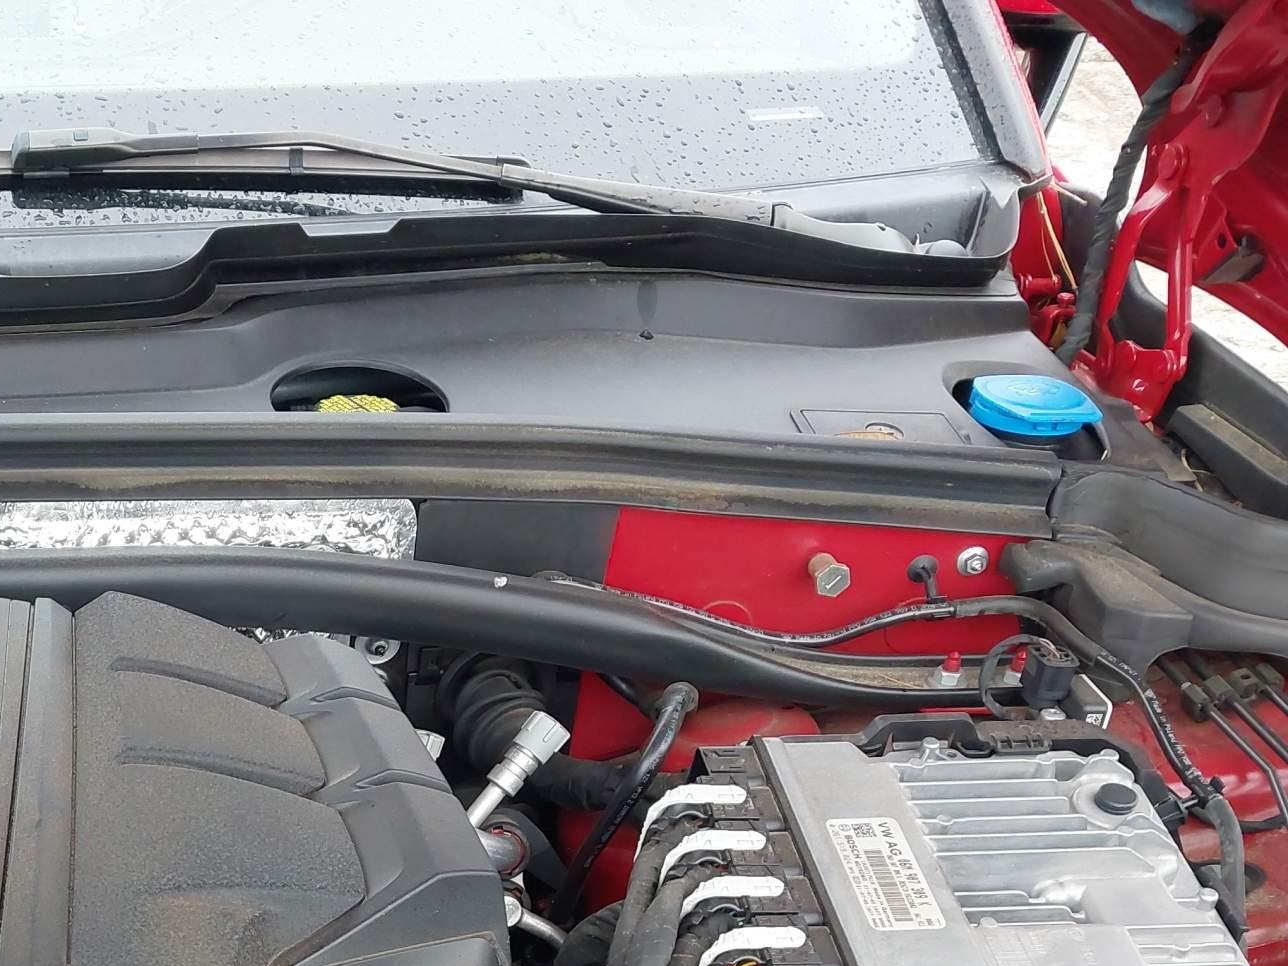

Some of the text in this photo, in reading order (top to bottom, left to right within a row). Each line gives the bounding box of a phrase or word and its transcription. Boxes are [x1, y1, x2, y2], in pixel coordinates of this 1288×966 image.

[844, 834, 862, 859] BOSCH
[878, 822, 894, 839] VW
[887, 841, 902, 857] AG
